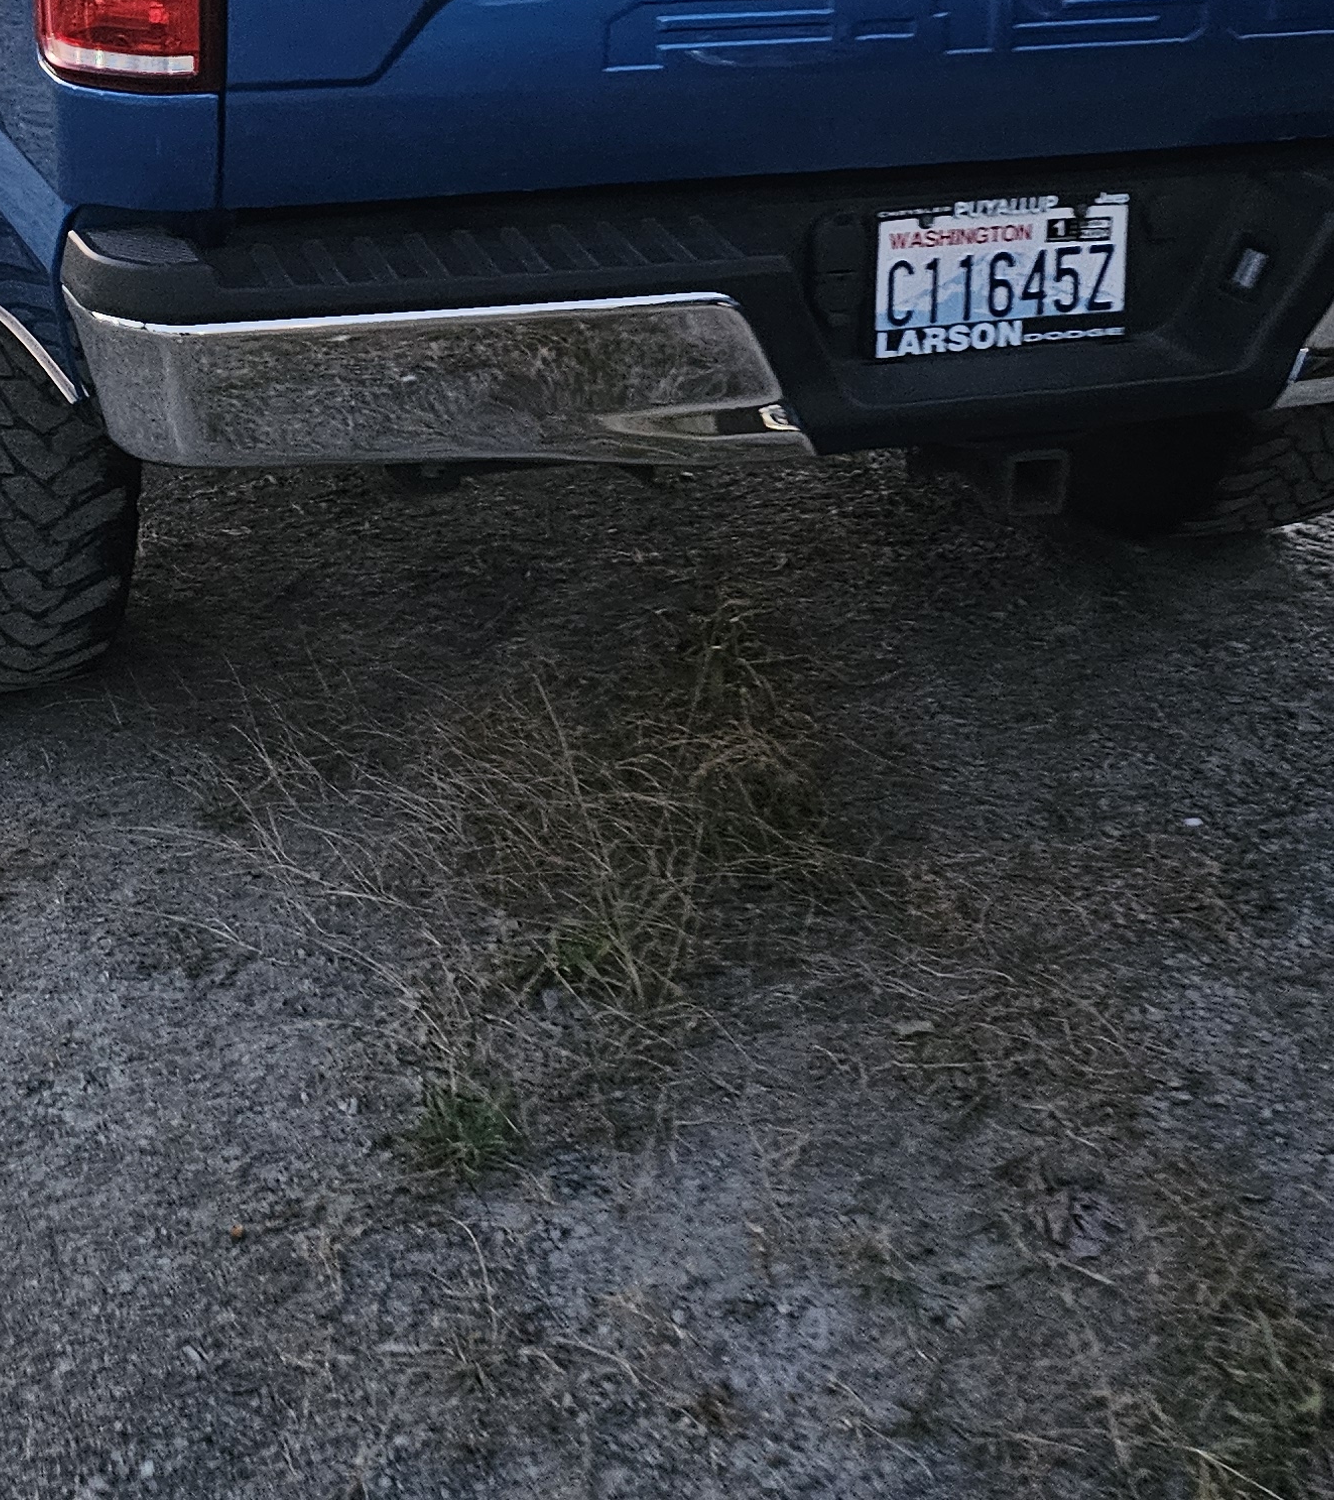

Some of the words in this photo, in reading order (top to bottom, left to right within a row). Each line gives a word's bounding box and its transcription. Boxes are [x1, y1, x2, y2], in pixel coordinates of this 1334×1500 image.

[953, 194, 1059, 219] PUYALLUP
[888, 223, 1032, 251] WASHINGTON
[887, 243, 1115, 327] C11645Z
[875, 319, 1023, 359] LARSON
[1023, 326, 1125, 343] DODGE
